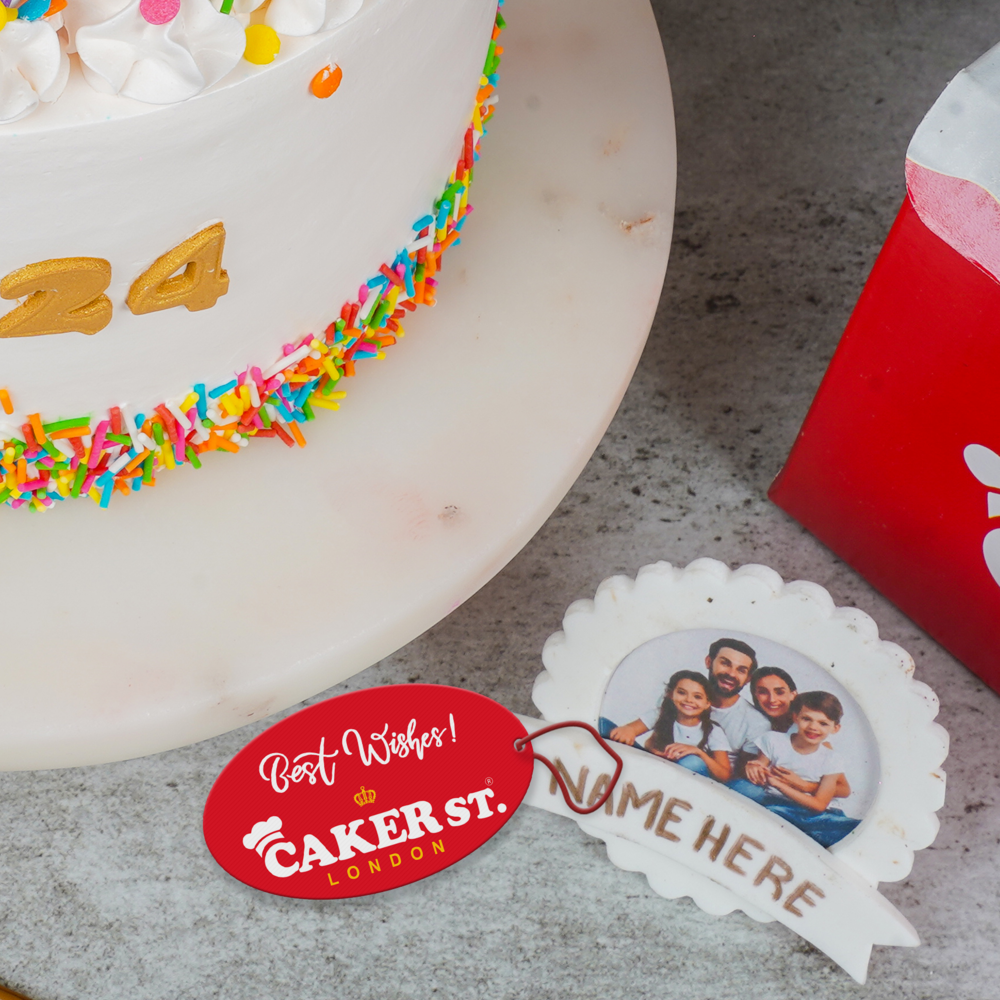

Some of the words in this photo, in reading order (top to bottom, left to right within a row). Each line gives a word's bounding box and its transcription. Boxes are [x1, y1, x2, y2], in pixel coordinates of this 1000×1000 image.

[258, 736, 339, 793] Best
[341, 712, 457, 767] Wishes!
[262, 799, 444, 878] CAKER
[444, 787, 508, 827] ST.
[327, 838, 446, 887] LONDON
[548, 756, 693, 843] NAME
[692, 814, 826, 918] HERE
